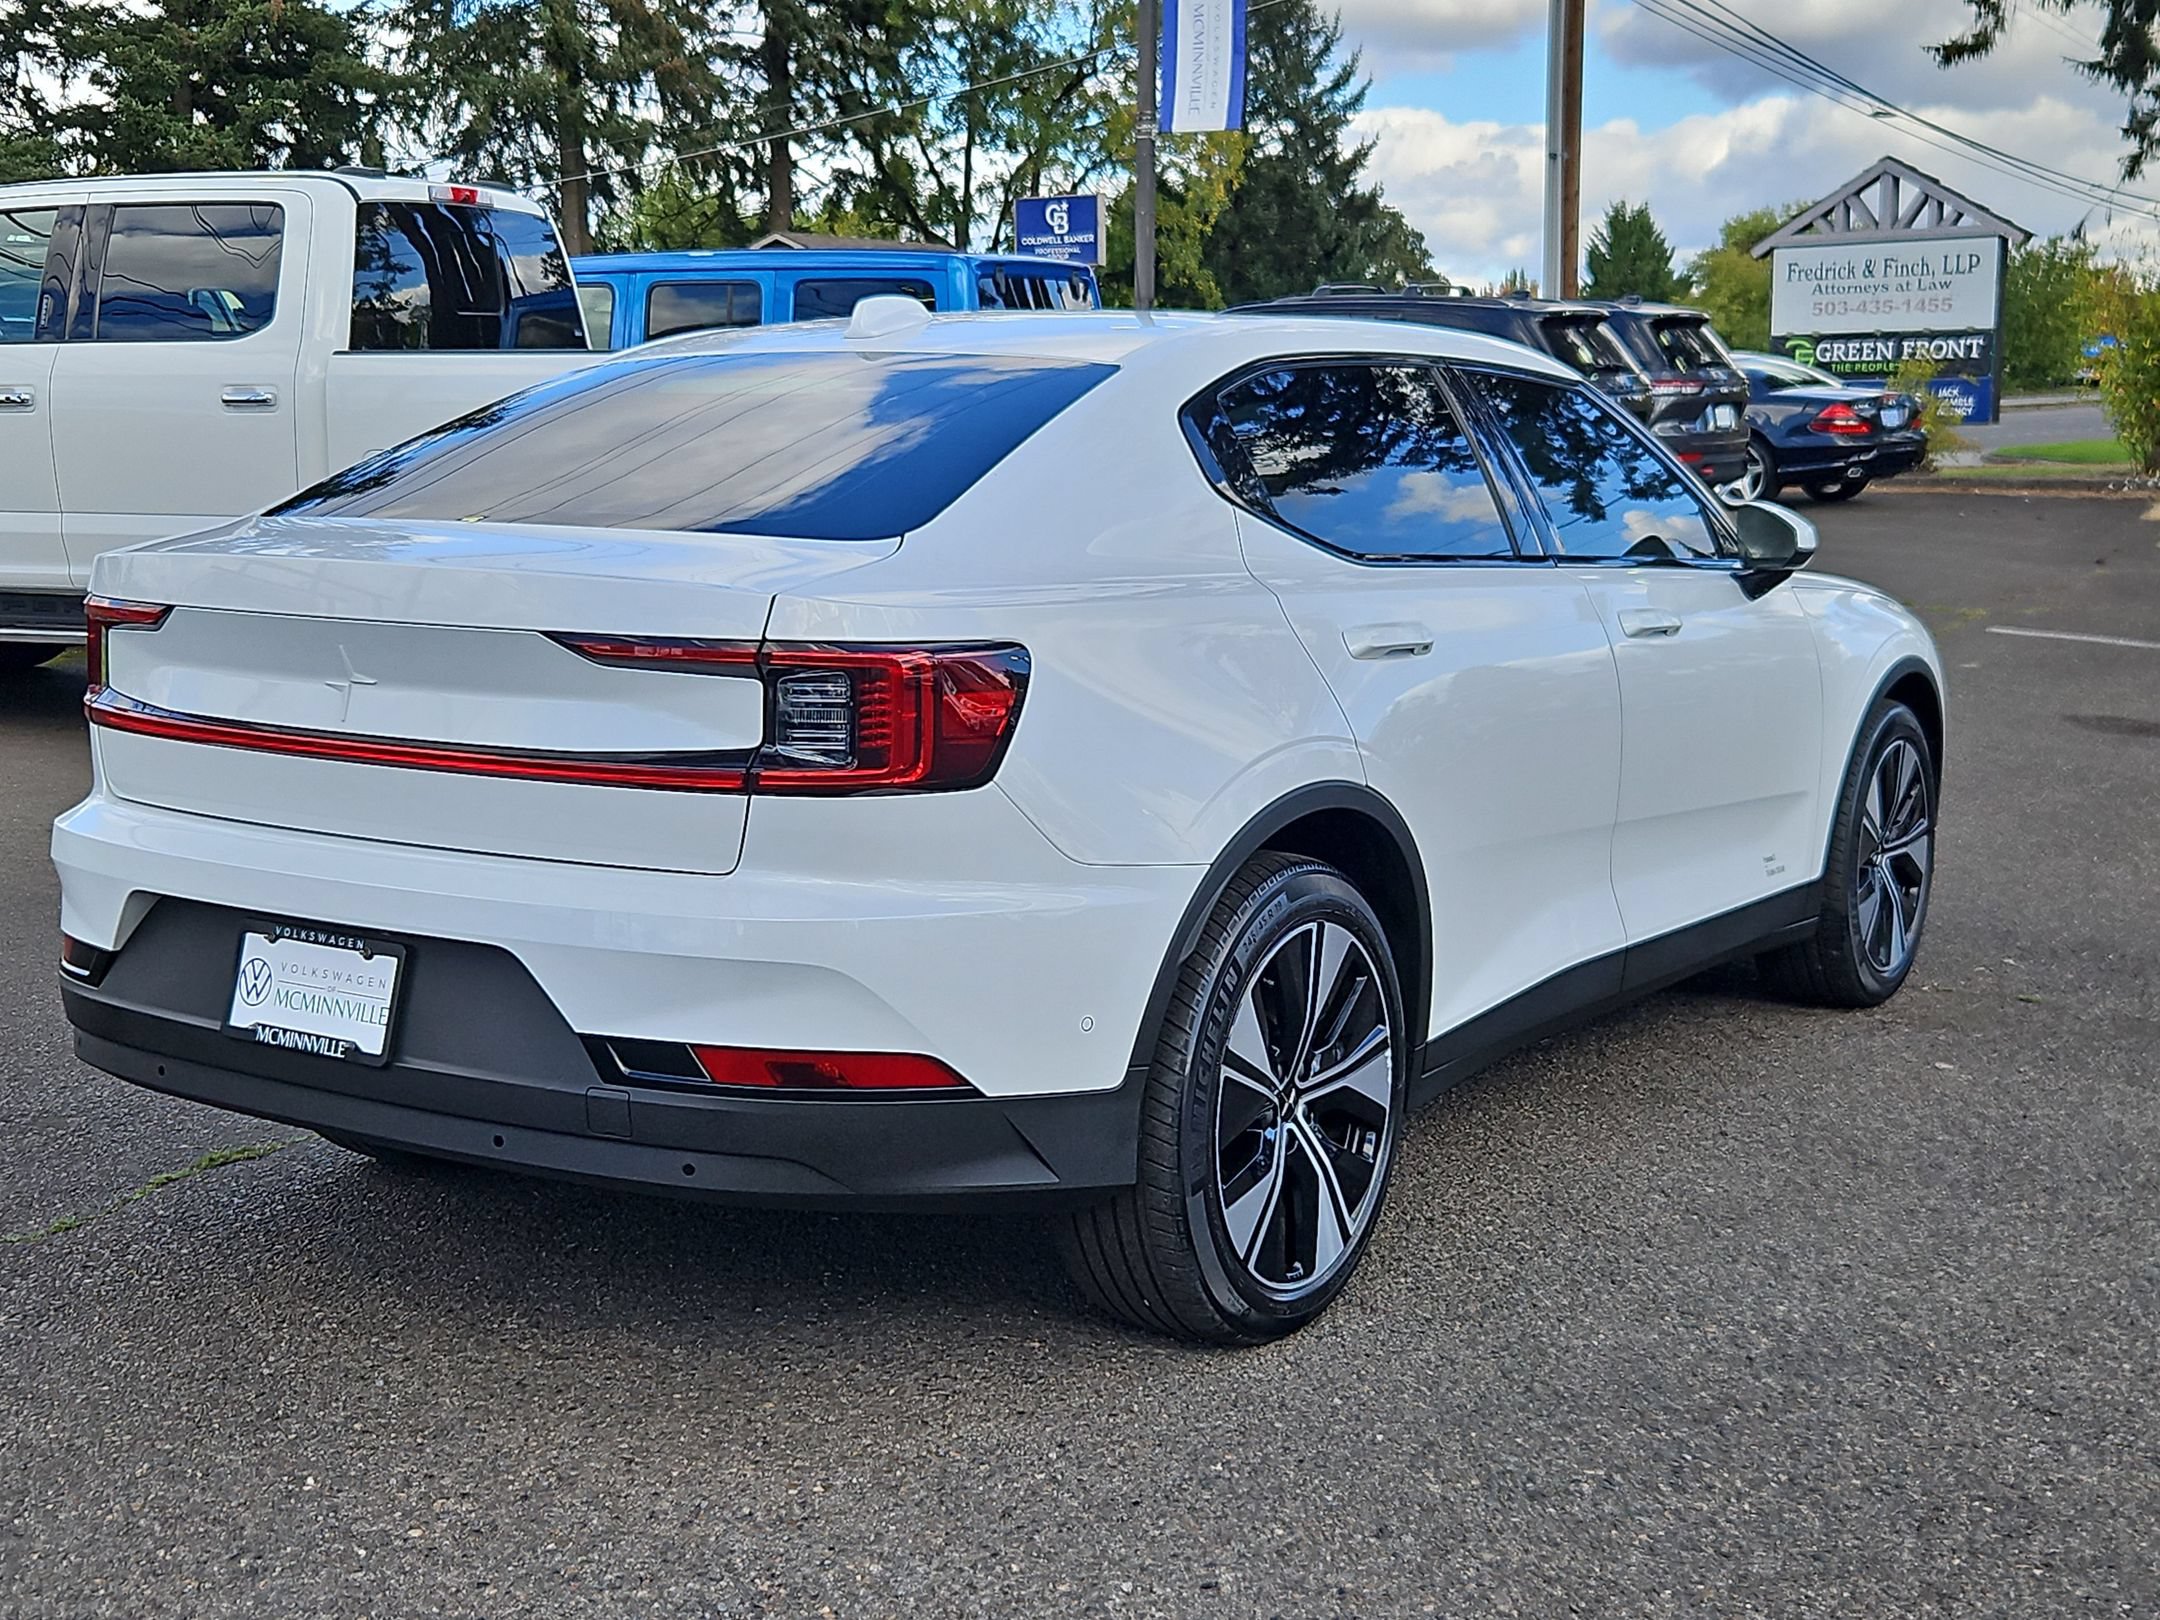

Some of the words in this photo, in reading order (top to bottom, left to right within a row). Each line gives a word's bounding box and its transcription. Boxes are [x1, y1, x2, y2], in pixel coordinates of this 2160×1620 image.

[1188, 3, 1205, 117] MCMINNVILLE
[1021, 236, 1062, 246] COLDWELL
[1063, 234, 1095, 244] BANKER
[1786, 257, 1856, 283] Fredrick
[1862, 258, 1877, 279] &
[1882, 255, 1935, 279] Finch,
[1943, 253, 1981, 275] LLP
[1811, 281, 1890, 296] Attorneys
[1895, 280, 1911, 292] at
[1917, 278, 1952, 292] Law
[1811, 297, 1953, 317] 503-435-1455
[1815, 340, 1894, 363] GREEN
[1901, 336, 1985, 361] FRONT
[1831, 363, 1851, 373] THE
[275, 925, 365, 949] VOLKSWAGEN
[281, 962, 388, 989] VOLKSWAGEN
[327, 985, 337, 993] OF
[274, 988, 390, 1026] MCMINNVILLE
[255, 1025, 346, 1058] MCMINNVILLE
[1190, 964, 1239, 1132] MICHELIN
